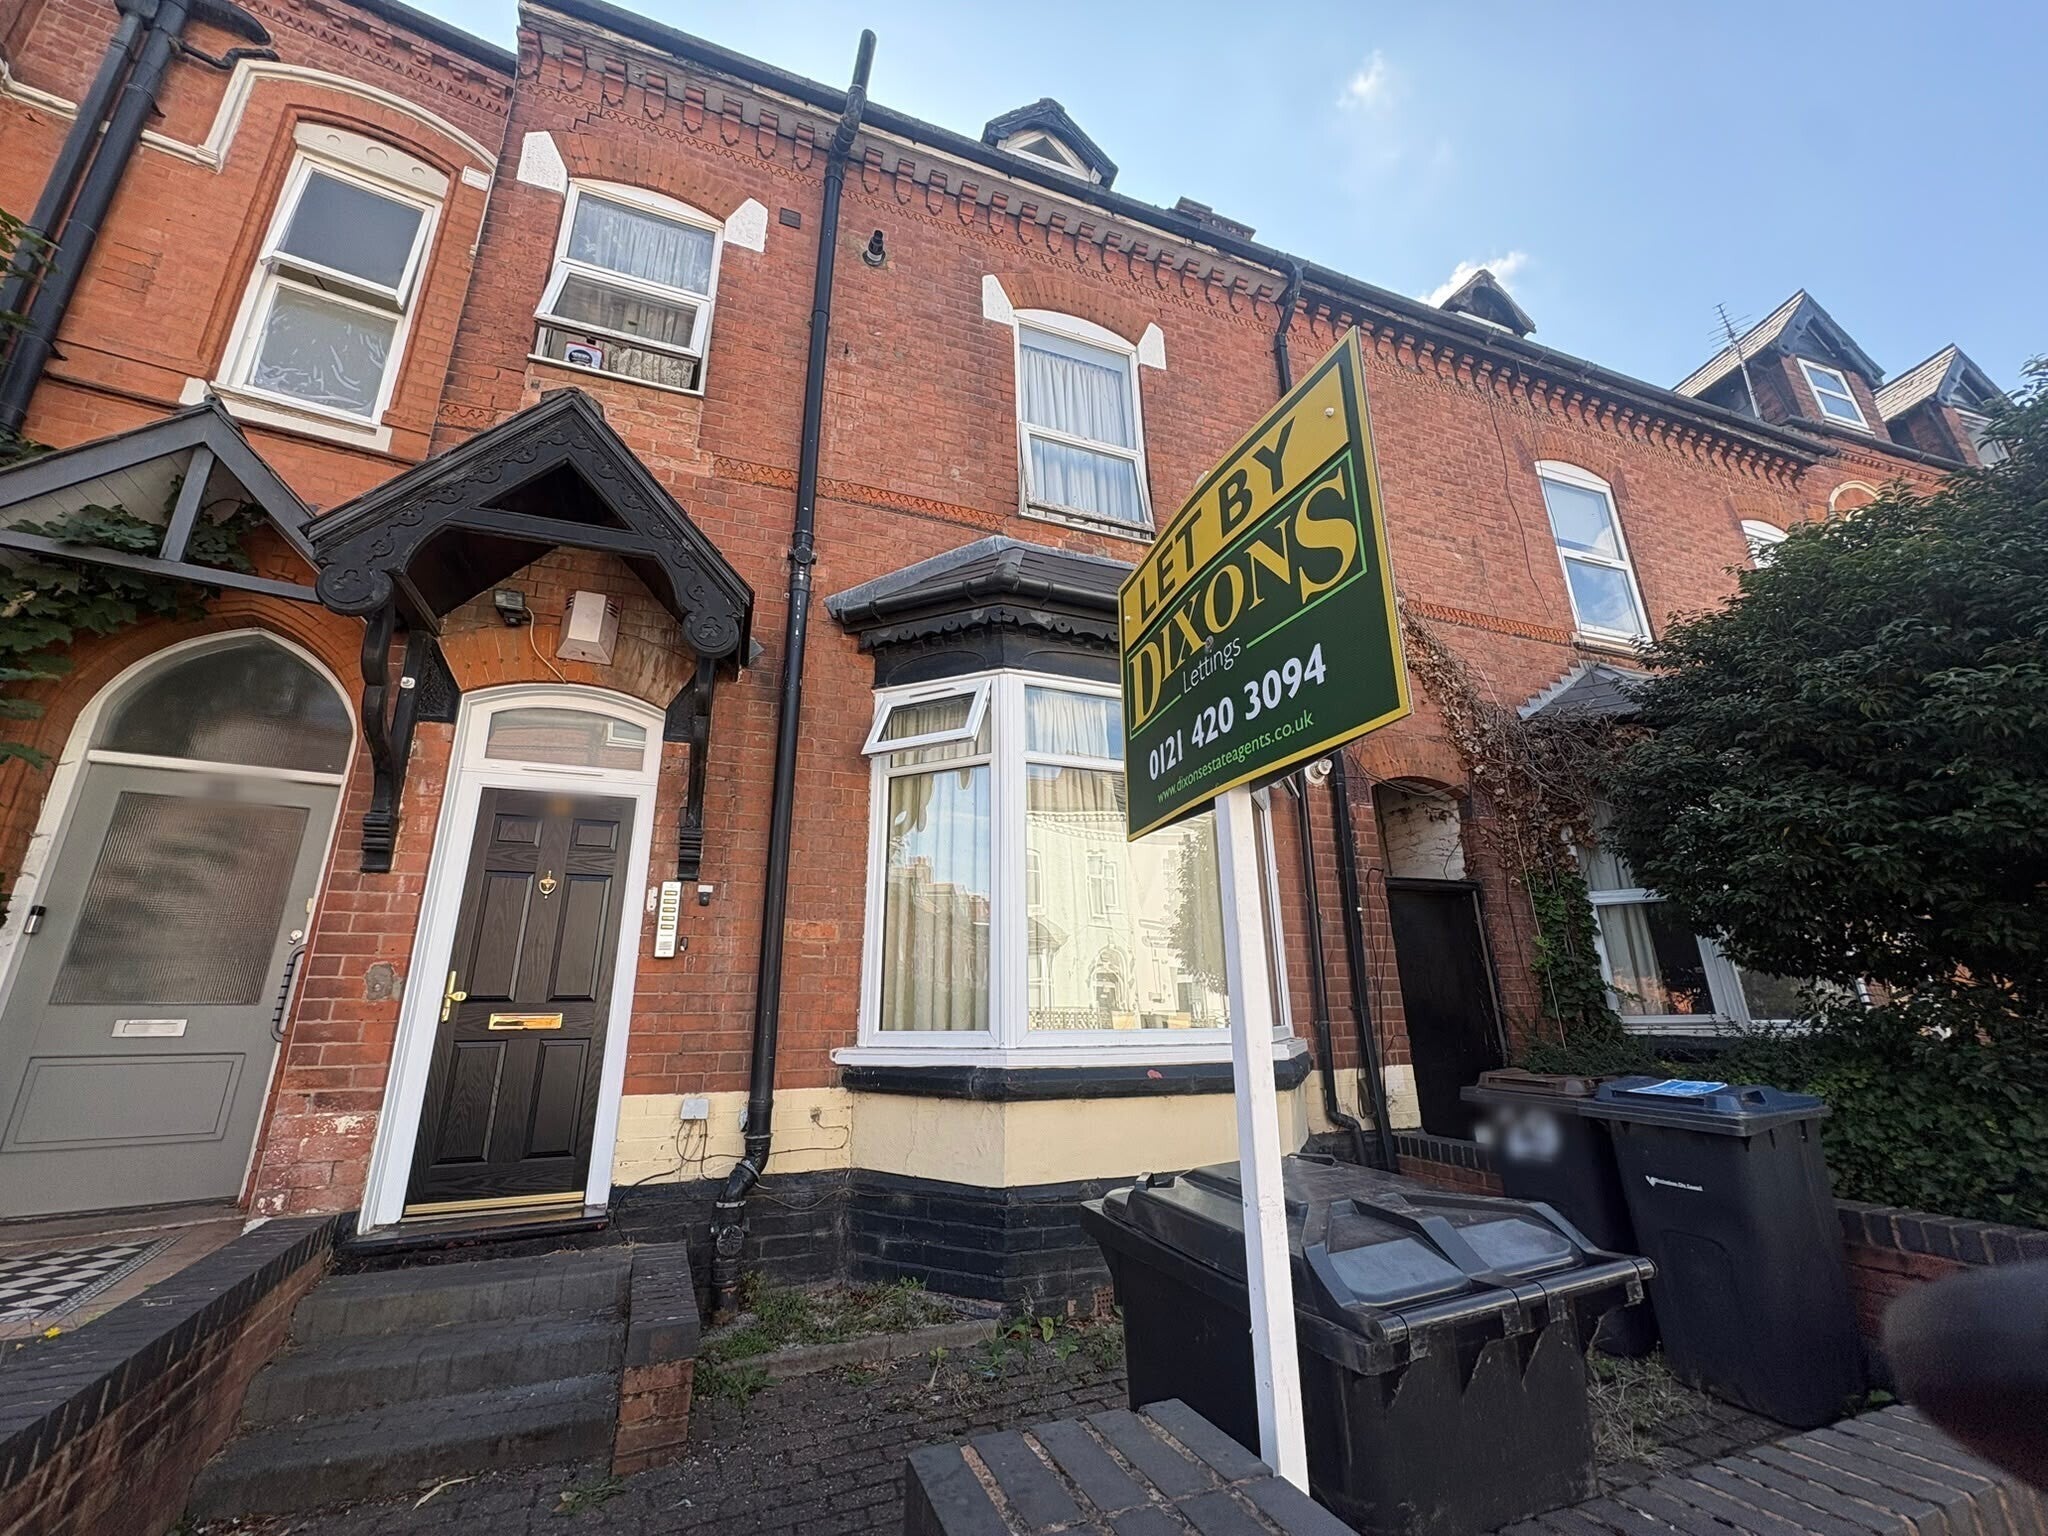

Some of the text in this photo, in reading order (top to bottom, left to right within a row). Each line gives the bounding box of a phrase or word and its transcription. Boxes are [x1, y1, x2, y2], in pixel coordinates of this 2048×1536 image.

[1139, 416, 1296, 625] LET BY
[1129, 466, 1357, 731] DIXONS
[1182, 637, 1241, 694] Lettings
[1149, 642, 1327, 781] 0121 420 3094
[1156, 709, 1315, 804] www.dixonsestateagents.co.uk
